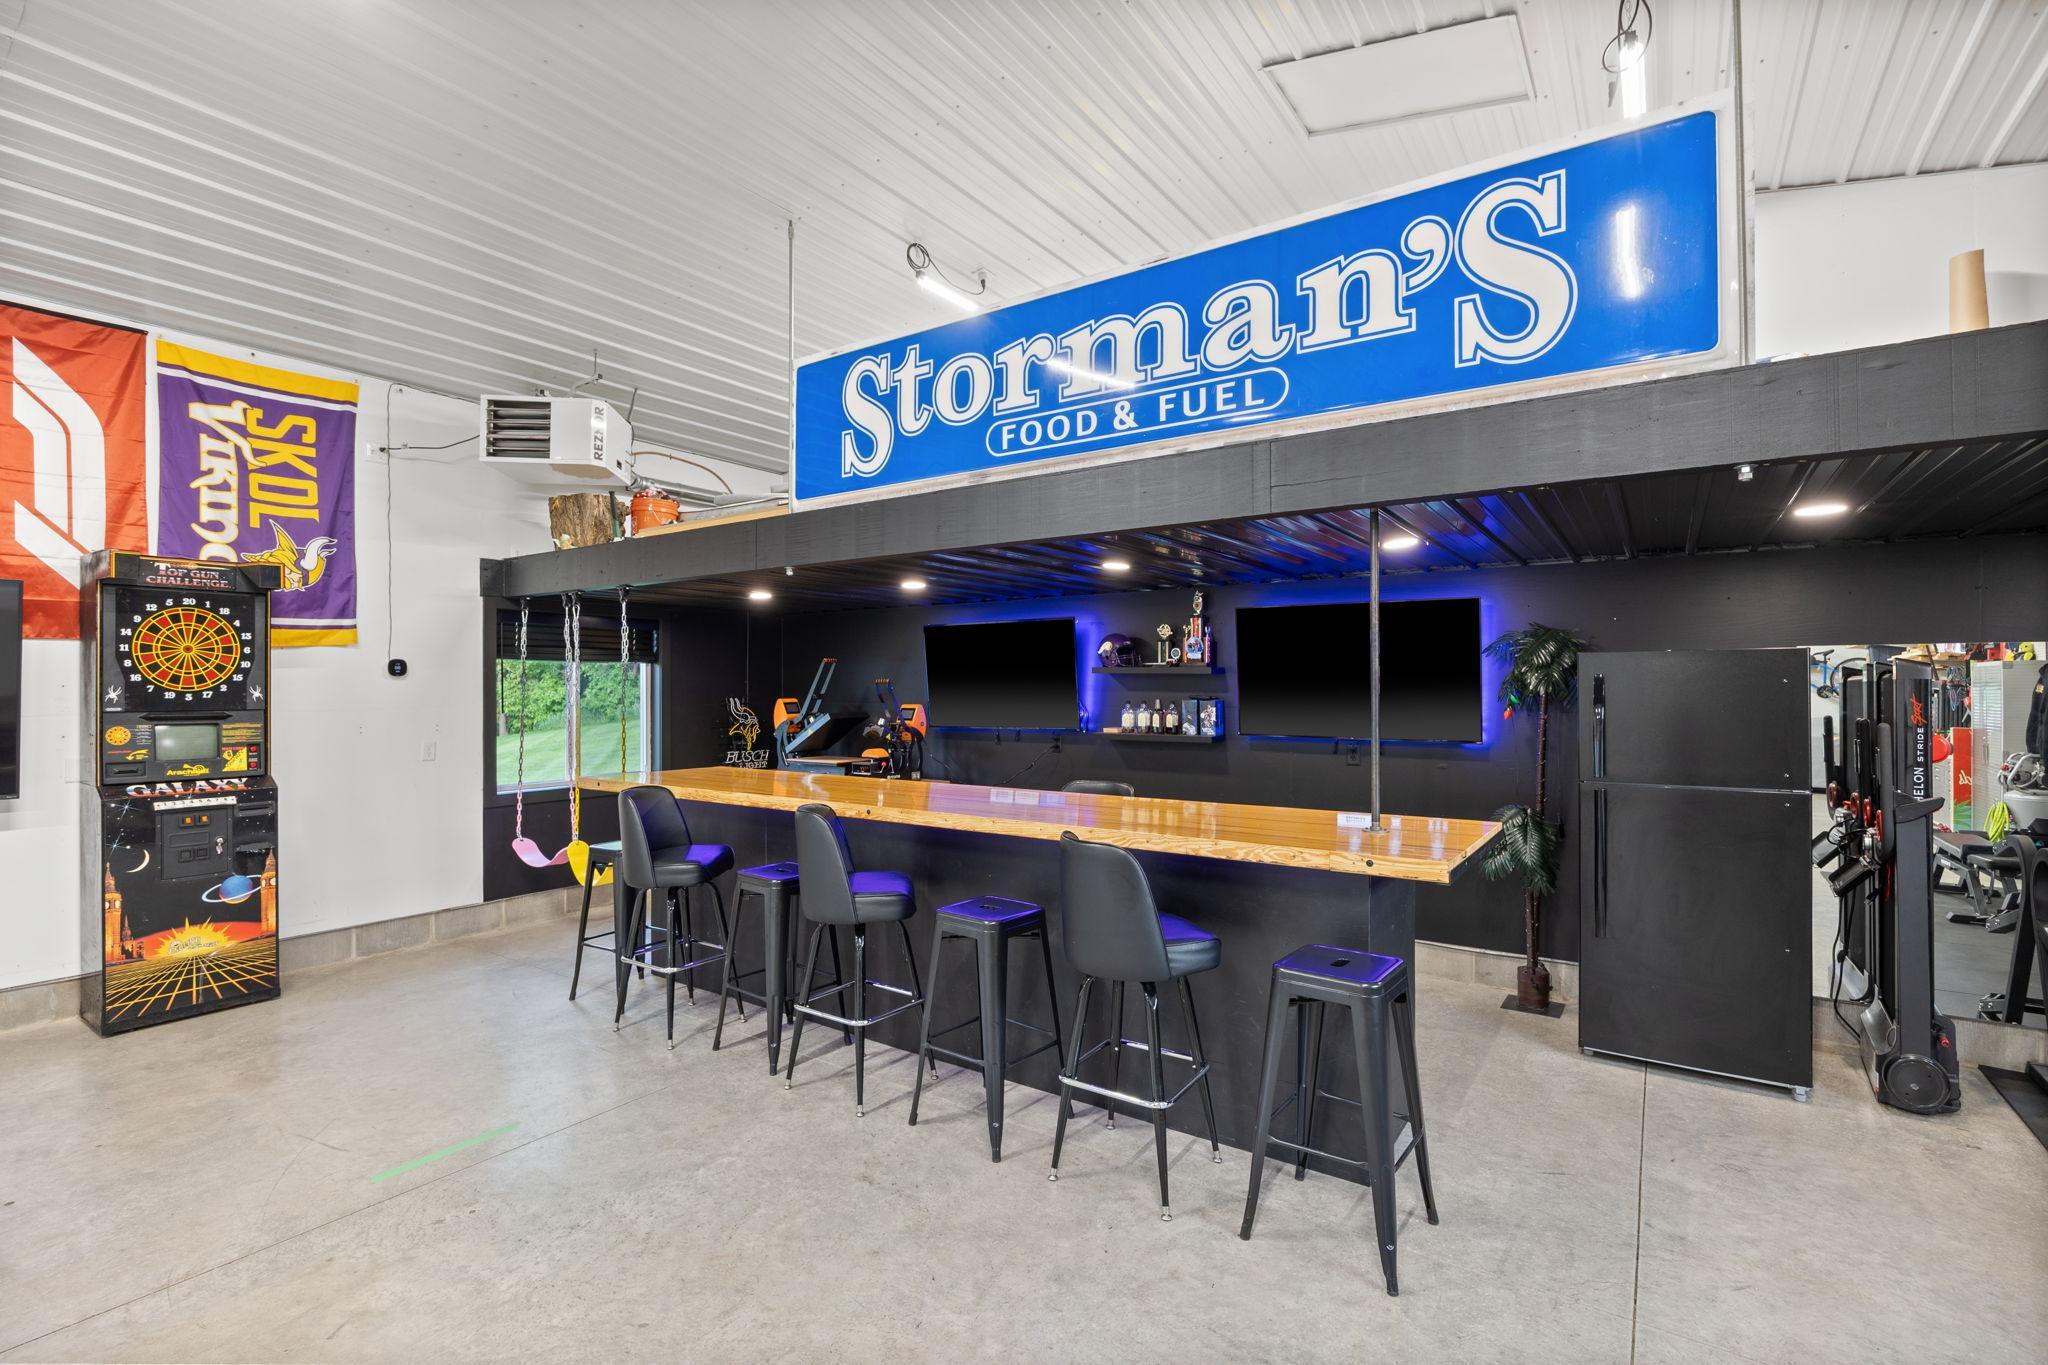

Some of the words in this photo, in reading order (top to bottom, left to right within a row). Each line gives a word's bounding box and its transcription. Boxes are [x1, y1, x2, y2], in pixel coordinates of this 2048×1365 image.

[1001, 410, 1098, 450] FOOD
[1113, 400, 1139, 431] &
[1159, 378, 1264, 422] FUEL
[246, 407, 320, 529] SKOL
[154, 562, 188, 577] TOP
[190, 570, 220, 580] GUN
[145, 575, 229, 588] CHALLENGE
[219, 607, 230, 615] 18
[133, 615, 142, 623] 9
[120, 628, 132, 636] 14
[147, 685, 155, 693] 7
[220, 684, 227, 692] 2
[202, 691, 213, 699] 17
[725, 749, 769, 763] BUSCH
[166, 767, 209, 776] Arach
[126, 777, 248, 797] GALAXY
